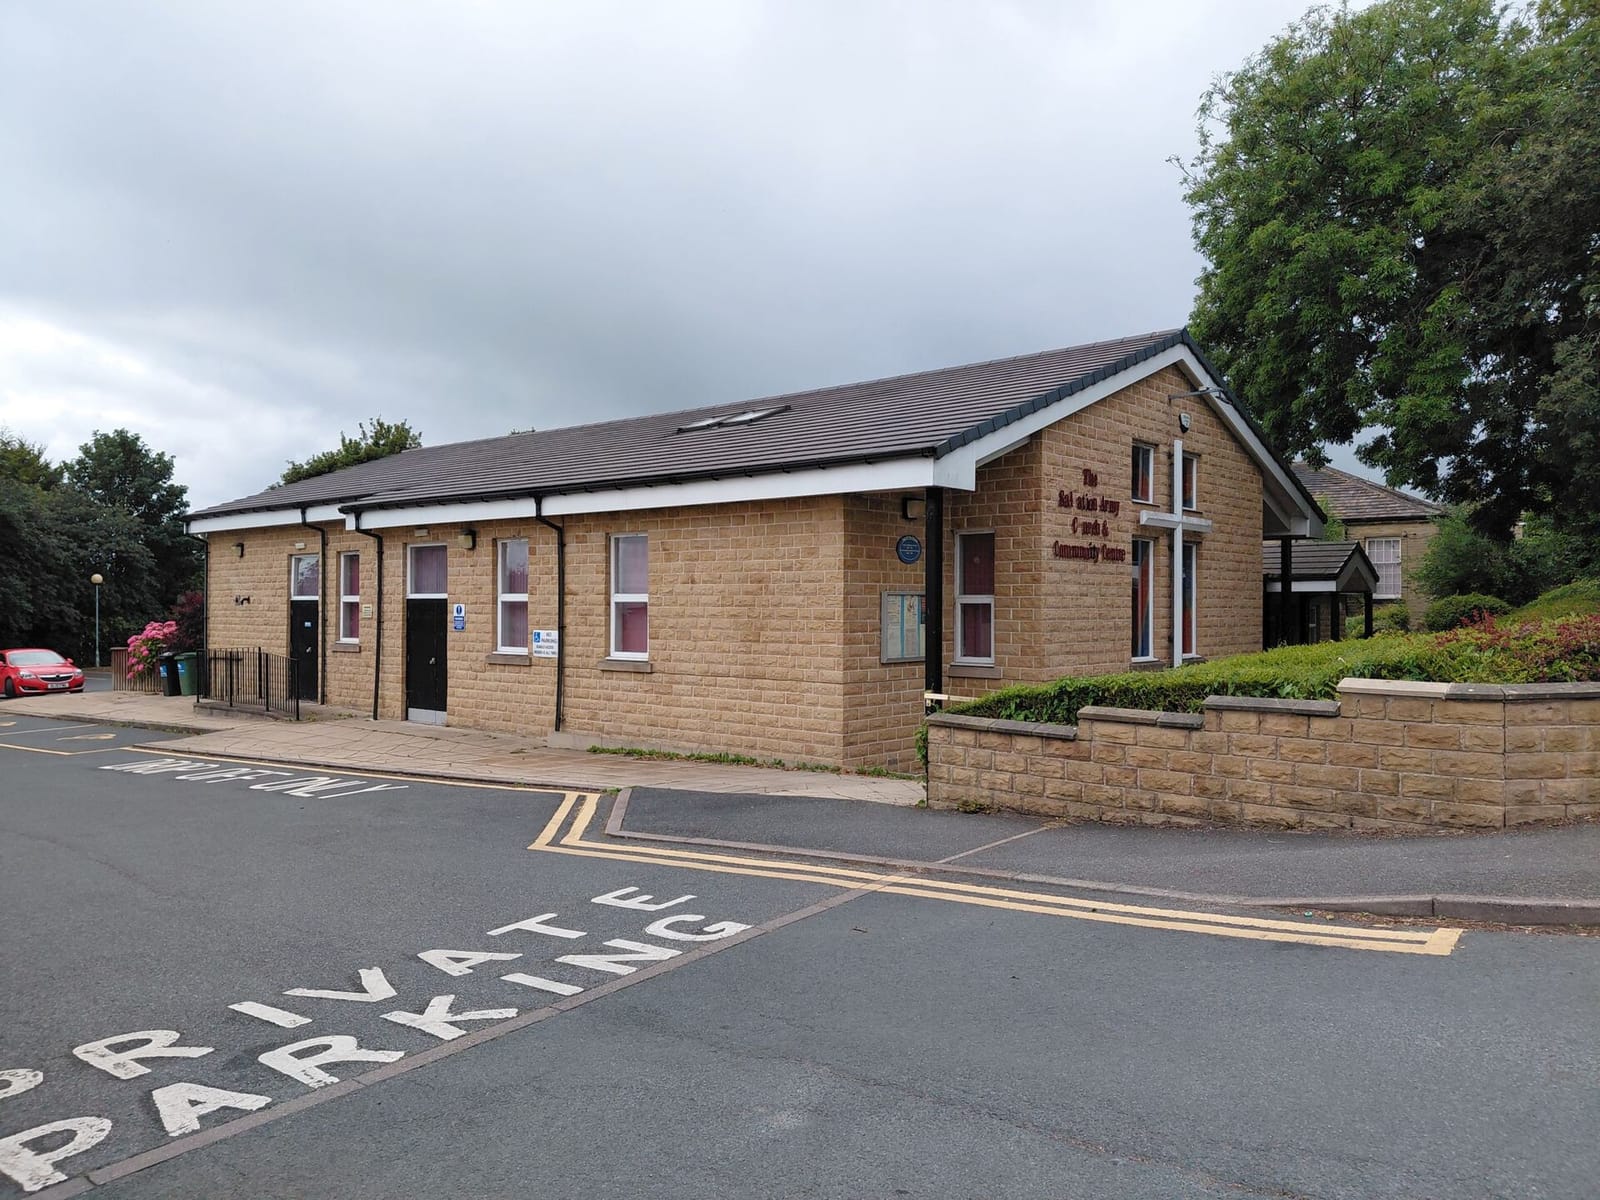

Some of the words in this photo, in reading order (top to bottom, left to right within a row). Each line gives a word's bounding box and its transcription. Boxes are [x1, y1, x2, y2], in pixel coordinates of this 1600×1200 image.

[1082, 469, 1098, 487] The
[1058, 490, 1097, 511] Salation
[1099, 496, 1120, 517] Army
[1071, 517, 1100, 536] Curch
[1101, 520, 1109, 537] &
[1053, 541, 1100, 563] Community
[1100, 544, 1126, 562] Centre
[248, 776, 408, 799] ONLY
[0, 914, 752, 1192] PARKING
